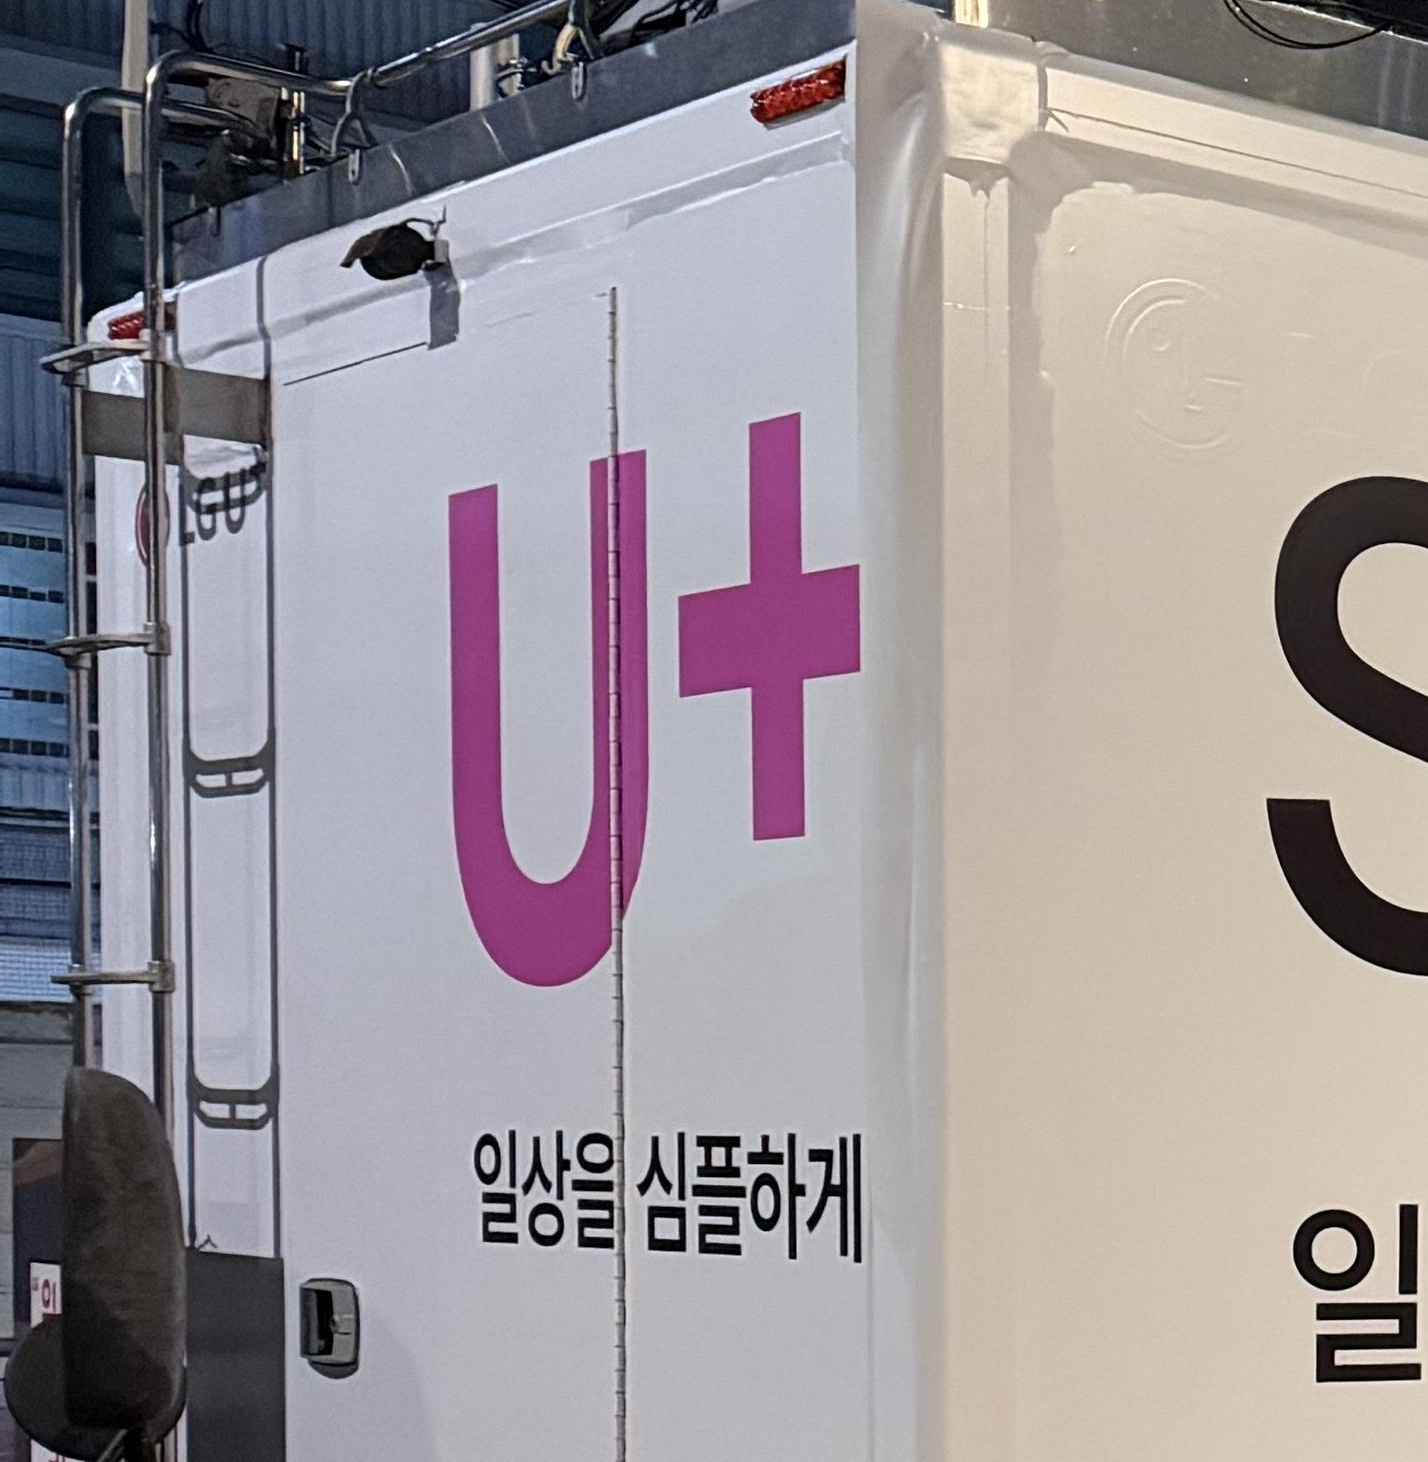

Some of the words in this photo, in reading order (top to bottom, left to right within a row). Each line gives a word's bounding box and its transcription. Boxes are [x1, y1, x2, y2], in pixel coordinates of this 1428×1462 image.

[449, 412, 861, 987] U+
[474, 1129, 614, 1250] 일상을
[636, 1131, 862, 1264] 심플하게
